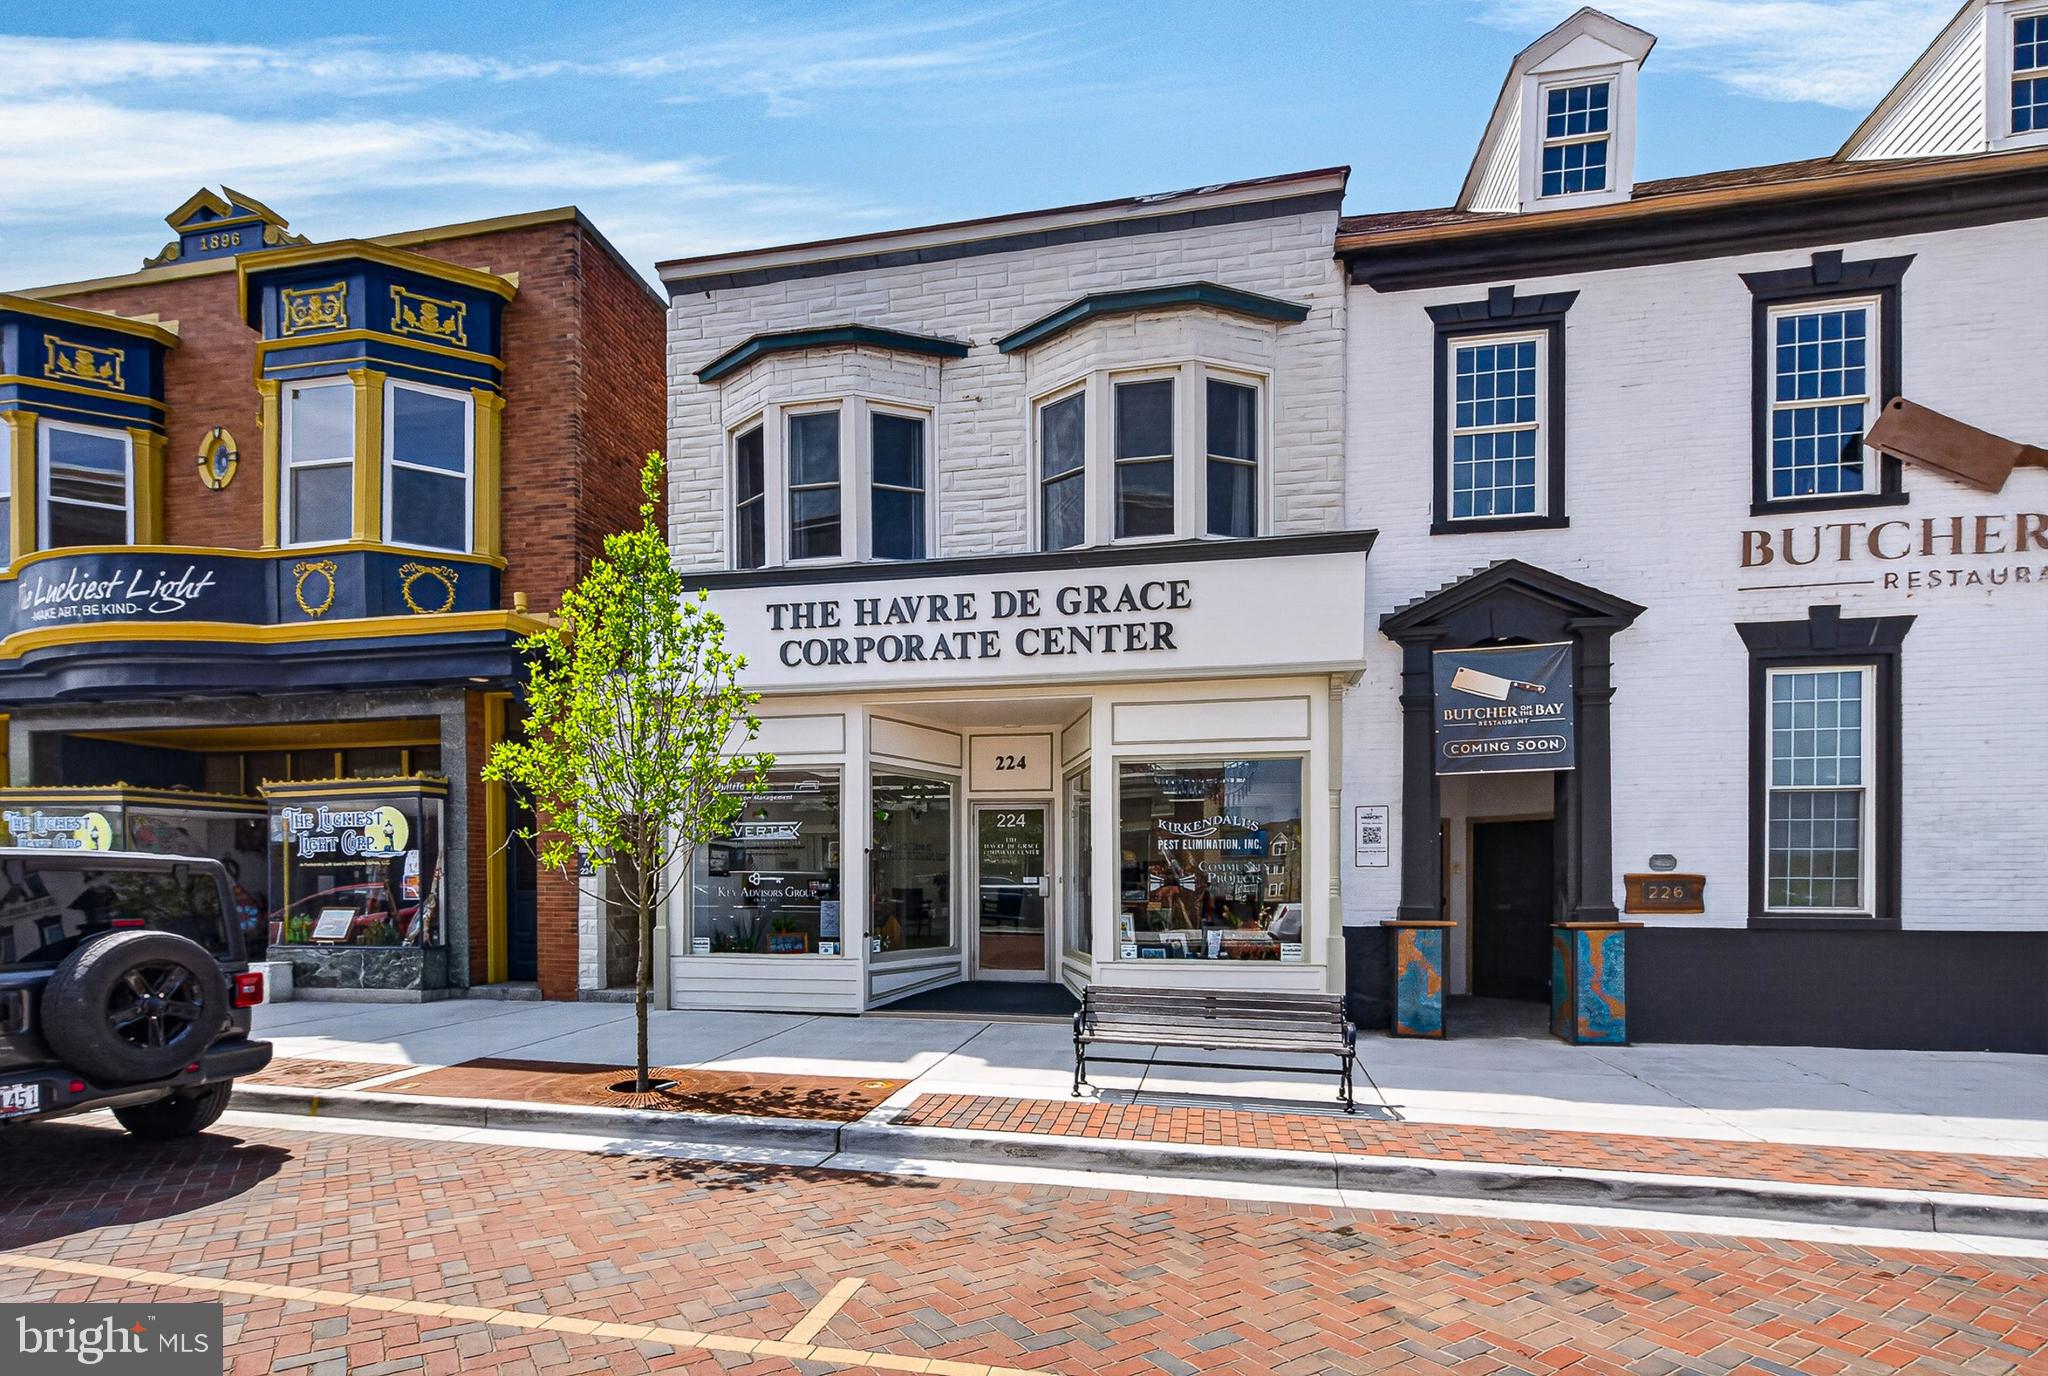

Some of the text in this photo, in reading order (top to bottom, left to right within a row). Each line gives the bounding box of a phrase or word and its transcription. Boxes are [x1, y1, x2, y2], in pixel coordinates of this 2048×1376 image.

[201, 232, 241, 250] 1896
[1740, 513, 2048, 567] BUTCHER
[34, 567, 125, 604] Luckiest
[126, 565, 216, 614] Light
[82, 605, 100, 616] BE
[766, 579, 1192, 631] THE HAVRE DE GRACE
[779, 621, 1178, 668] CORPORATE CENTER
[1443, 706, 1518, 720] BUTCHER
[1535, 703, 1564, 716] BAY
[1478, 717, 1530, 727] RESTAURANT
[1450, 739, 1559, 754] COMING SOON
[995, 755, 1027, 771] 224
[282, 806, 383, 833] THE LUCKIEST
[996, 813, 1026, 828] 224
[1158, 815, 1259, 833] KIRKENDALL'S
[733, 823, 800, 838] VERTEX
[297, 831, 338, 858] LIGHT
[1158, 839, 1180, 850] PEST
[1244, 839, 1262, 850] INC.
[1207, 873, 1263, 885] PROJECTS
[740, 887, 783, 897] ADVISORS
[785, 886, 817, 897] GROUP
[1648, 886, 1684, 899] 226
